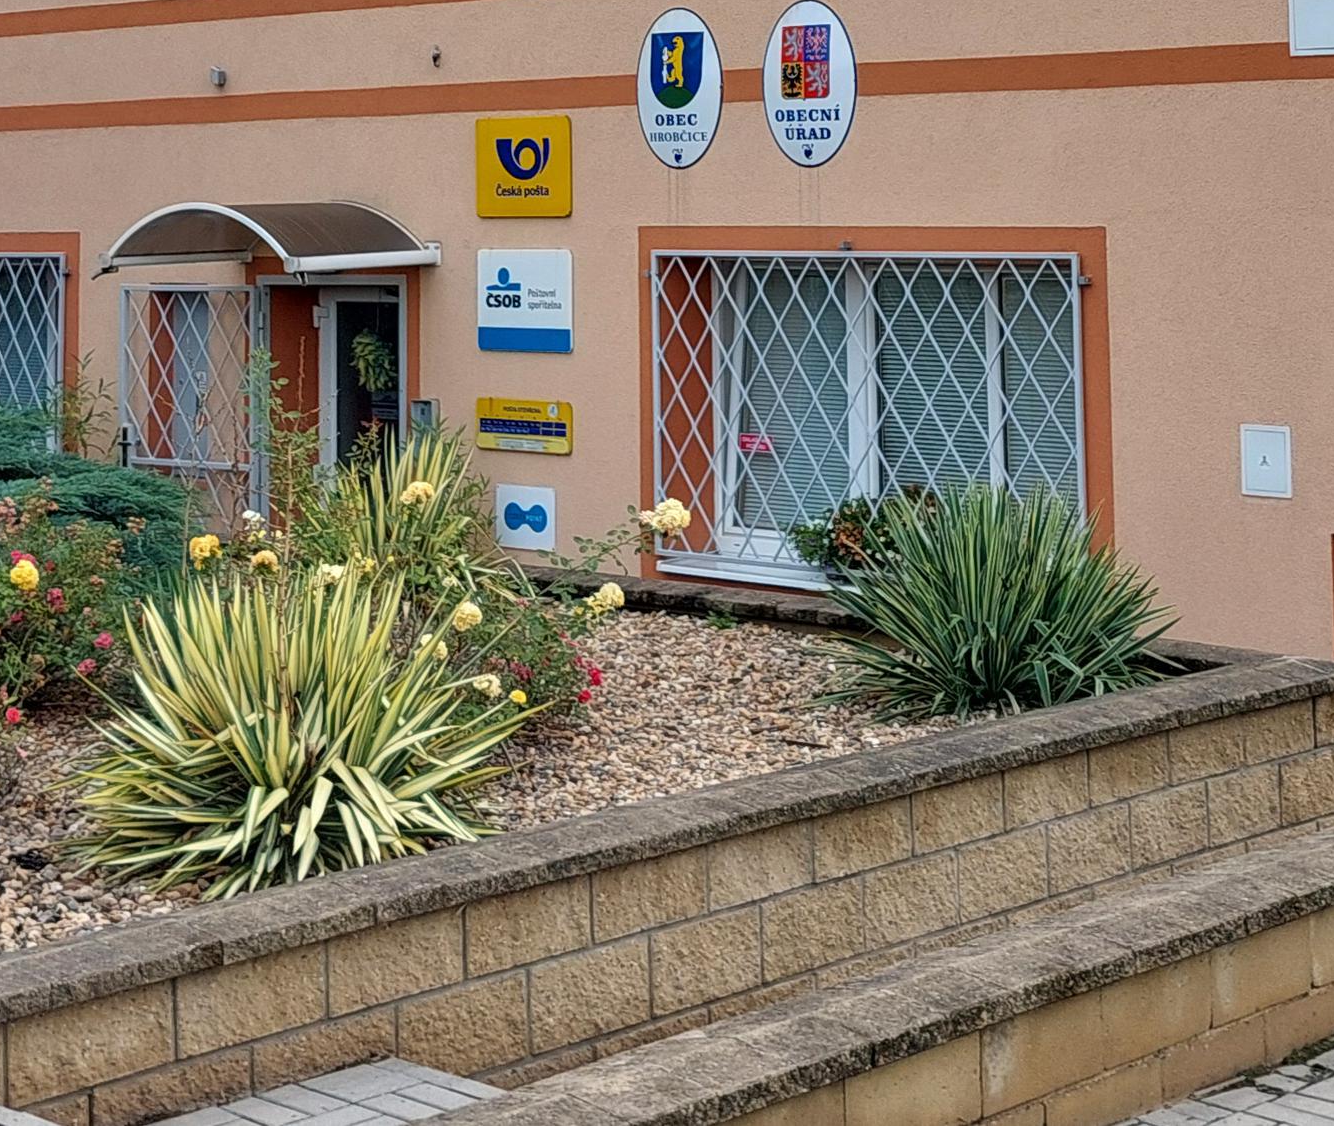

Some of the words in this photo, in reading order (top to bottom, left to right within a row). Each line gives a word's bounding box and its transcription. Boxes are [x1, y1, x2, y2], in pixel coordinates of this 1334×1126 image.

[655, 114, 698, 126] OBEC
[775, 104, 841, 122] OBECNÍ
[650, 130, 708, 142] HROBČICE
[785, 124, 831, 140] ÚŘAD
[496, 183, 522, 196] Česká
[524, 185, 549, 198] pošta
[486, 292, 521, 308] ČSOB
